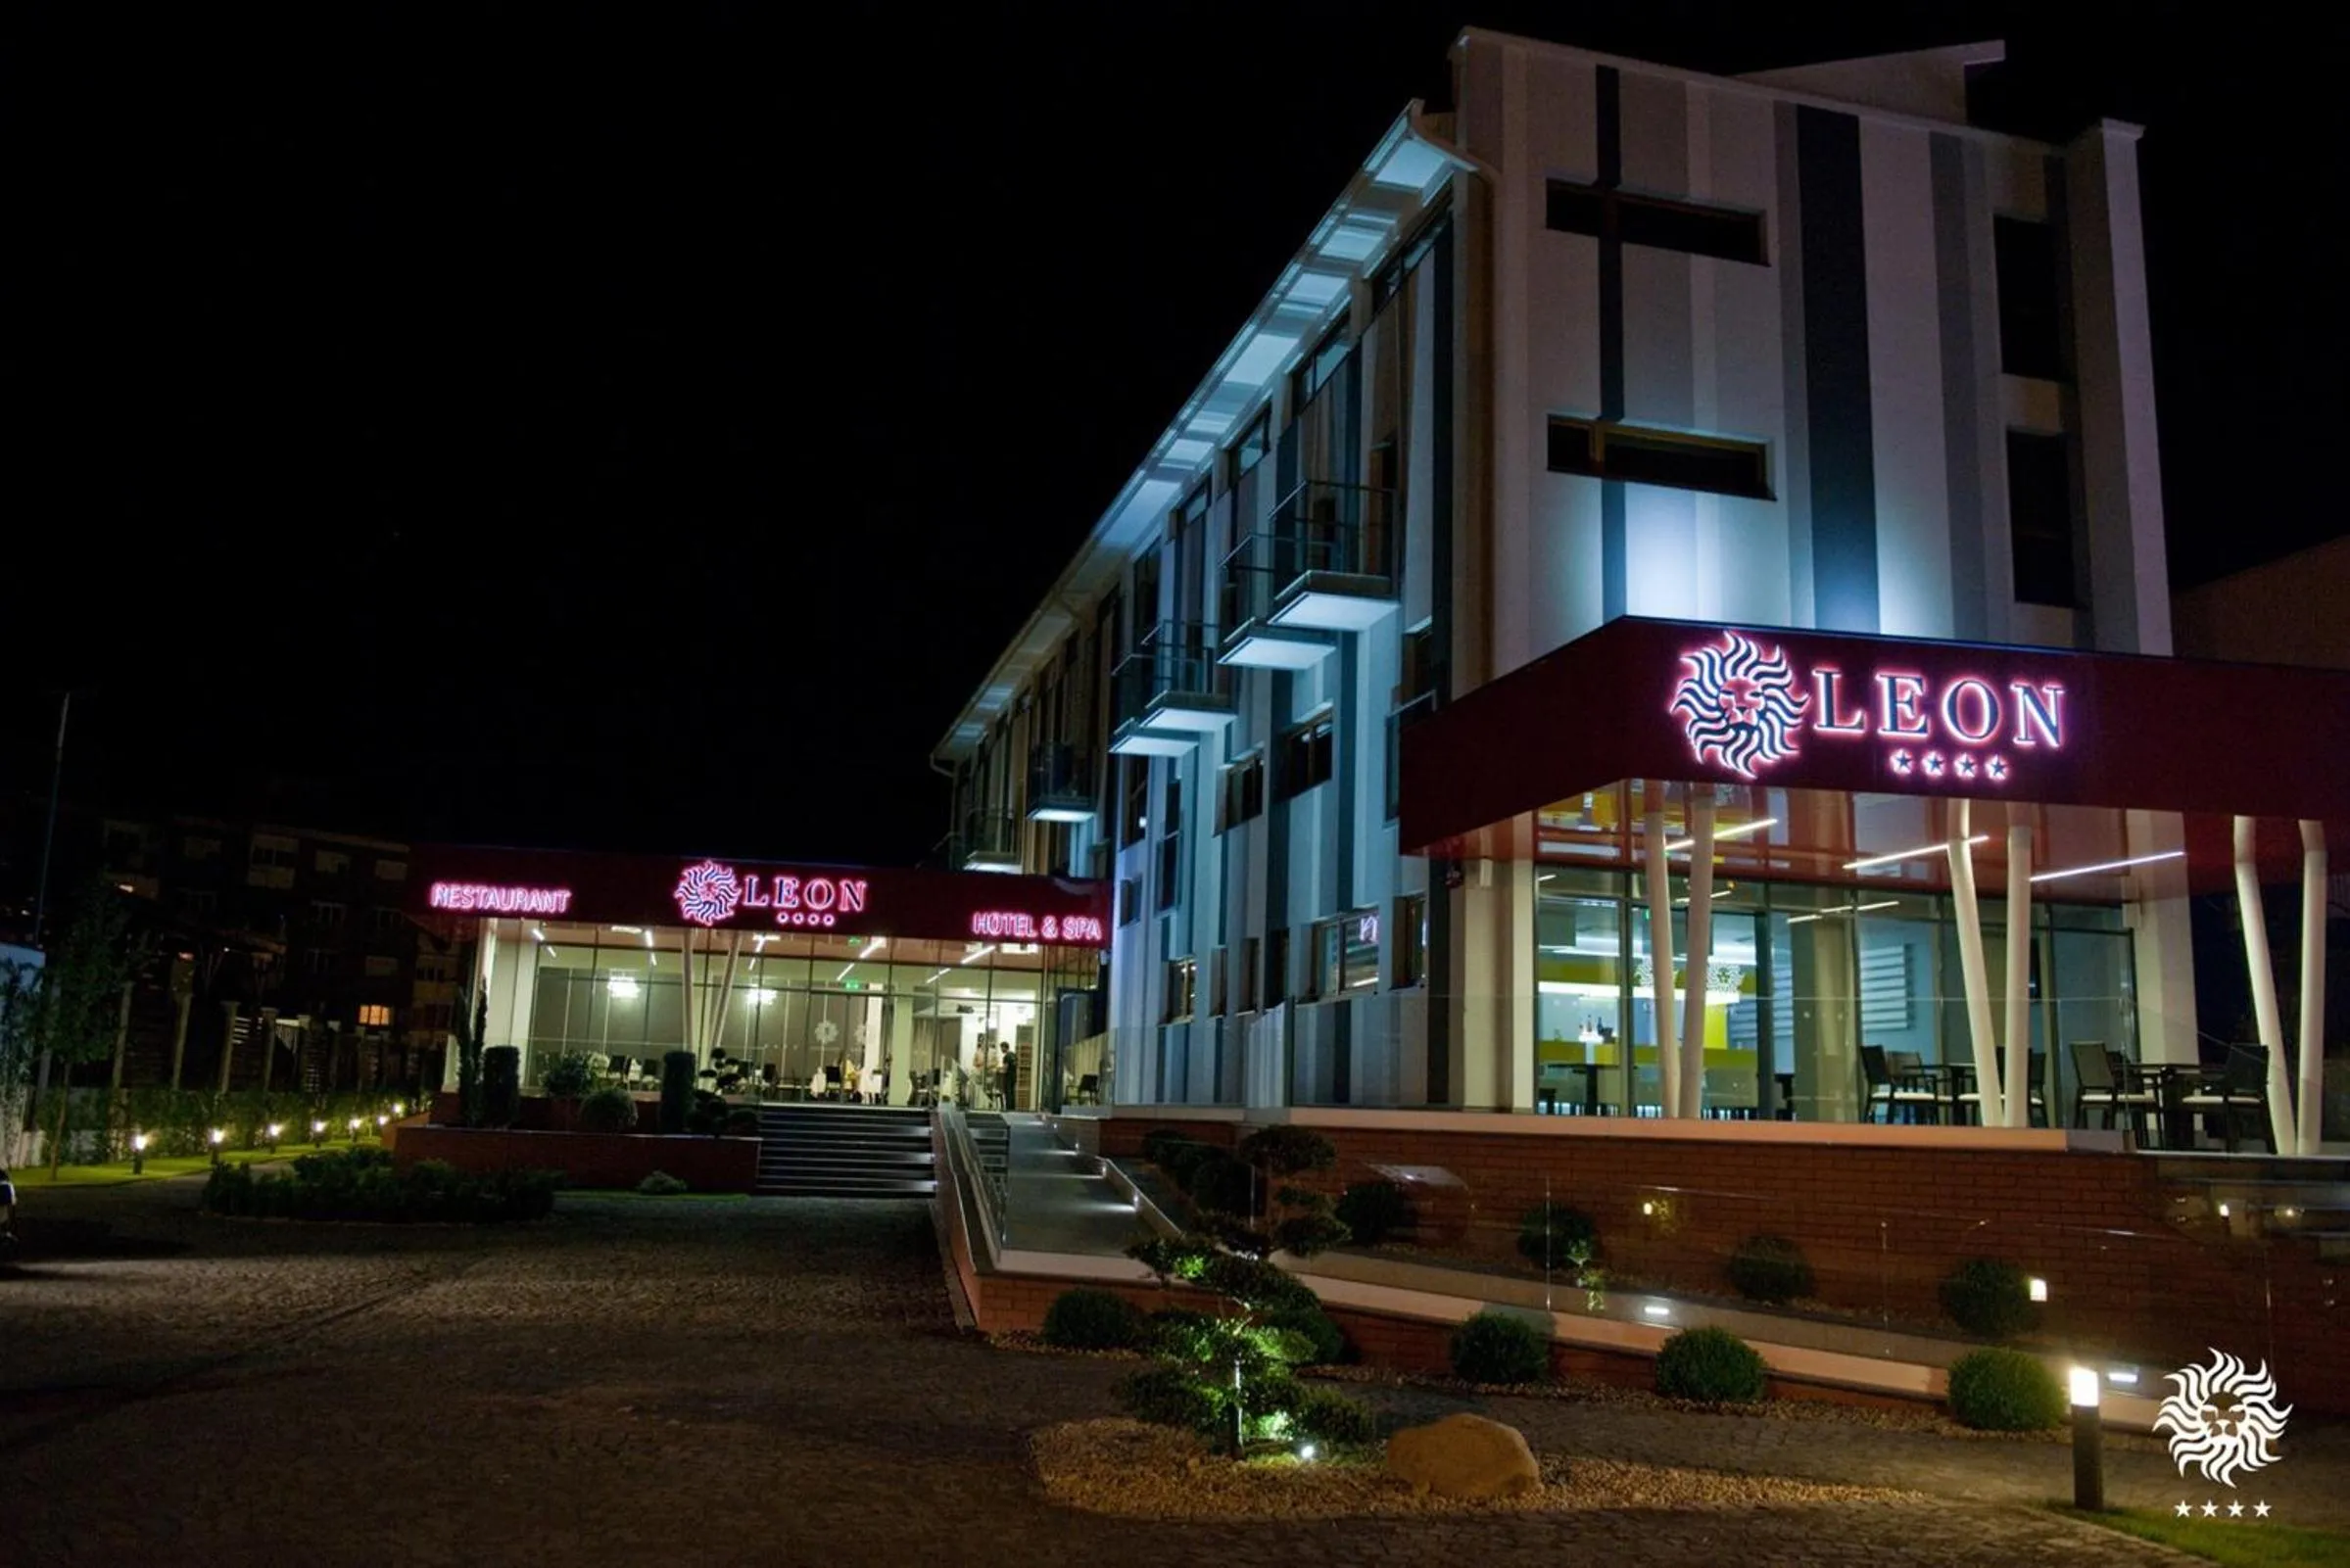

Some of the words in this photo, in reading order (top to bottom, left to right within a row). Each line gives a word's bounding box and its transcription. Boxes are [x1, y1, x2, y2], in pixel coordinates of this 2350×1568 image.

[1811, 667, 2065, 747] LEON
[430, 882, 572, 913] RESTAURANT
[743, 875, 868, 912] LEON
[973, 912, 1037, 937] HOTEL
[1041, 915, 1058, 939] &
[1062, 916, 1102, 940] SPA
